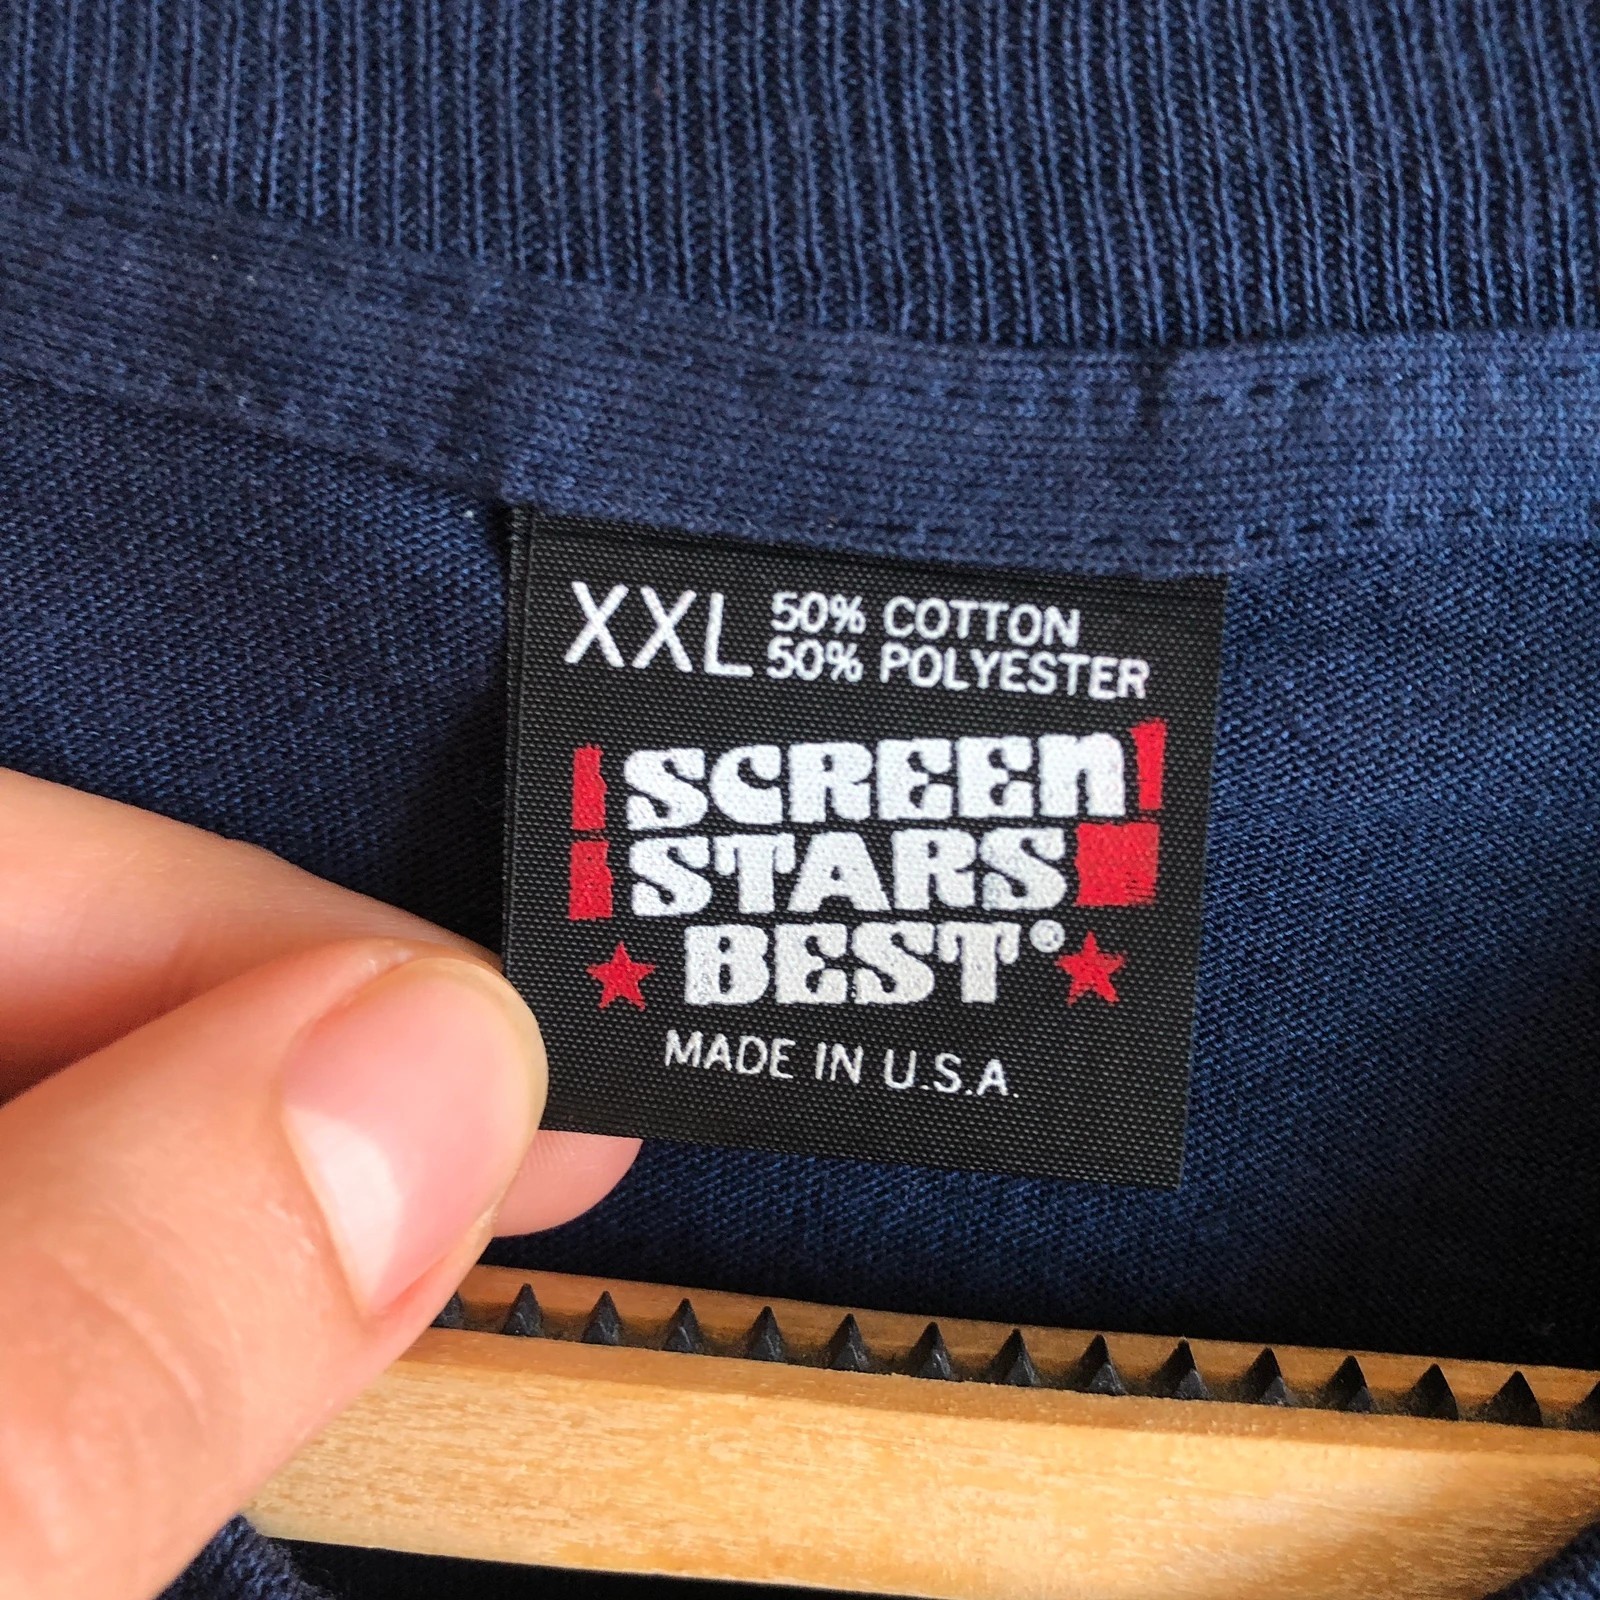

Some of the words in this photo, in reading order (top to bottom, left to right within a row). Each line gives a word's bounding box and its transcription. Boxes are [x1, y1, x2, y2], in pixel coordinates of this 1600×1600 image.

[564, 581, 754, 678] XXL
[770, 591, 867, 636] 50%
[883, 596, 1081, 648] COTTON
[766, 639, 863, 682] 50%
[879, 643, 1150, 700] POLYESTER
[629, 827, 1067, 917] STARS
[664, 1030, 796, 1081] MADE
[814, 1042, 865, 1086] IN
